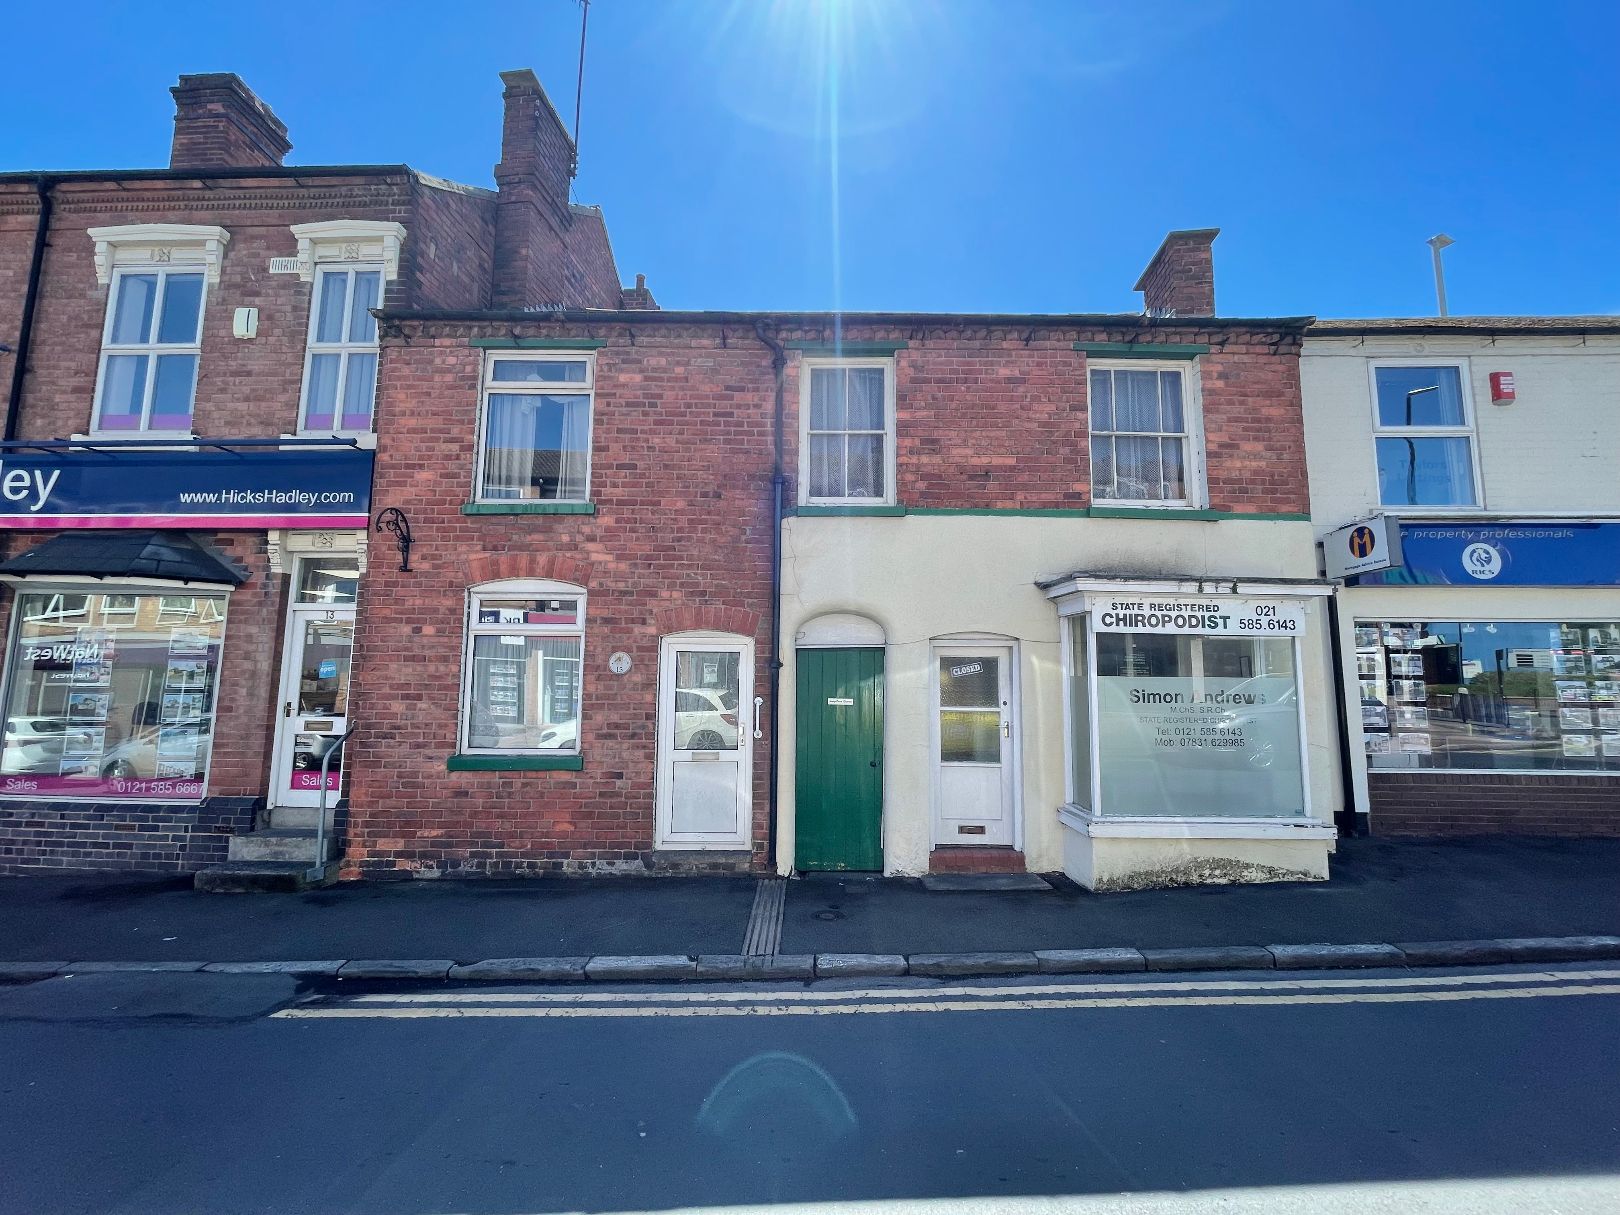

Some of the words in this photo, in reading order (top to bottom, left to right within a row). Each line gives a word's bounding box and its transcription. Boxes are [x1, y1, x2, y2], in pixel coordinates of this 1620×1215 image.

[0, 460, 61, 511] ey
[180, 489, 354, 506] www.HicksHadley.com
[1414, 528, 1474, 539] property
[1479, 528, 1574, 539] professionals
[1111, 602, 1144, 611] STATE
[1149, 603, 1220, 612] REGISTERED
[1255, 605, 1276, 617] 021
[325, 610, 335, 620] 13
[1101, 612, 1230, 629] CHIROPODIST
[1239, 618, 1296, 631] 585.6143
[952, 663, 981, 676] CLOSED
[1129, 688, 1183, 704] Simon
[1174, 728, 1197, 736] 0121
[1199, 728, 1219, 736] 585
[1219, 728, 1243, 737] 6143
[6, 778, 38, 791] Sales
[117, 781, 146, 793] 0121
[150, 781, 173, 793] 585
[301, 774, 333, 786] Sals
